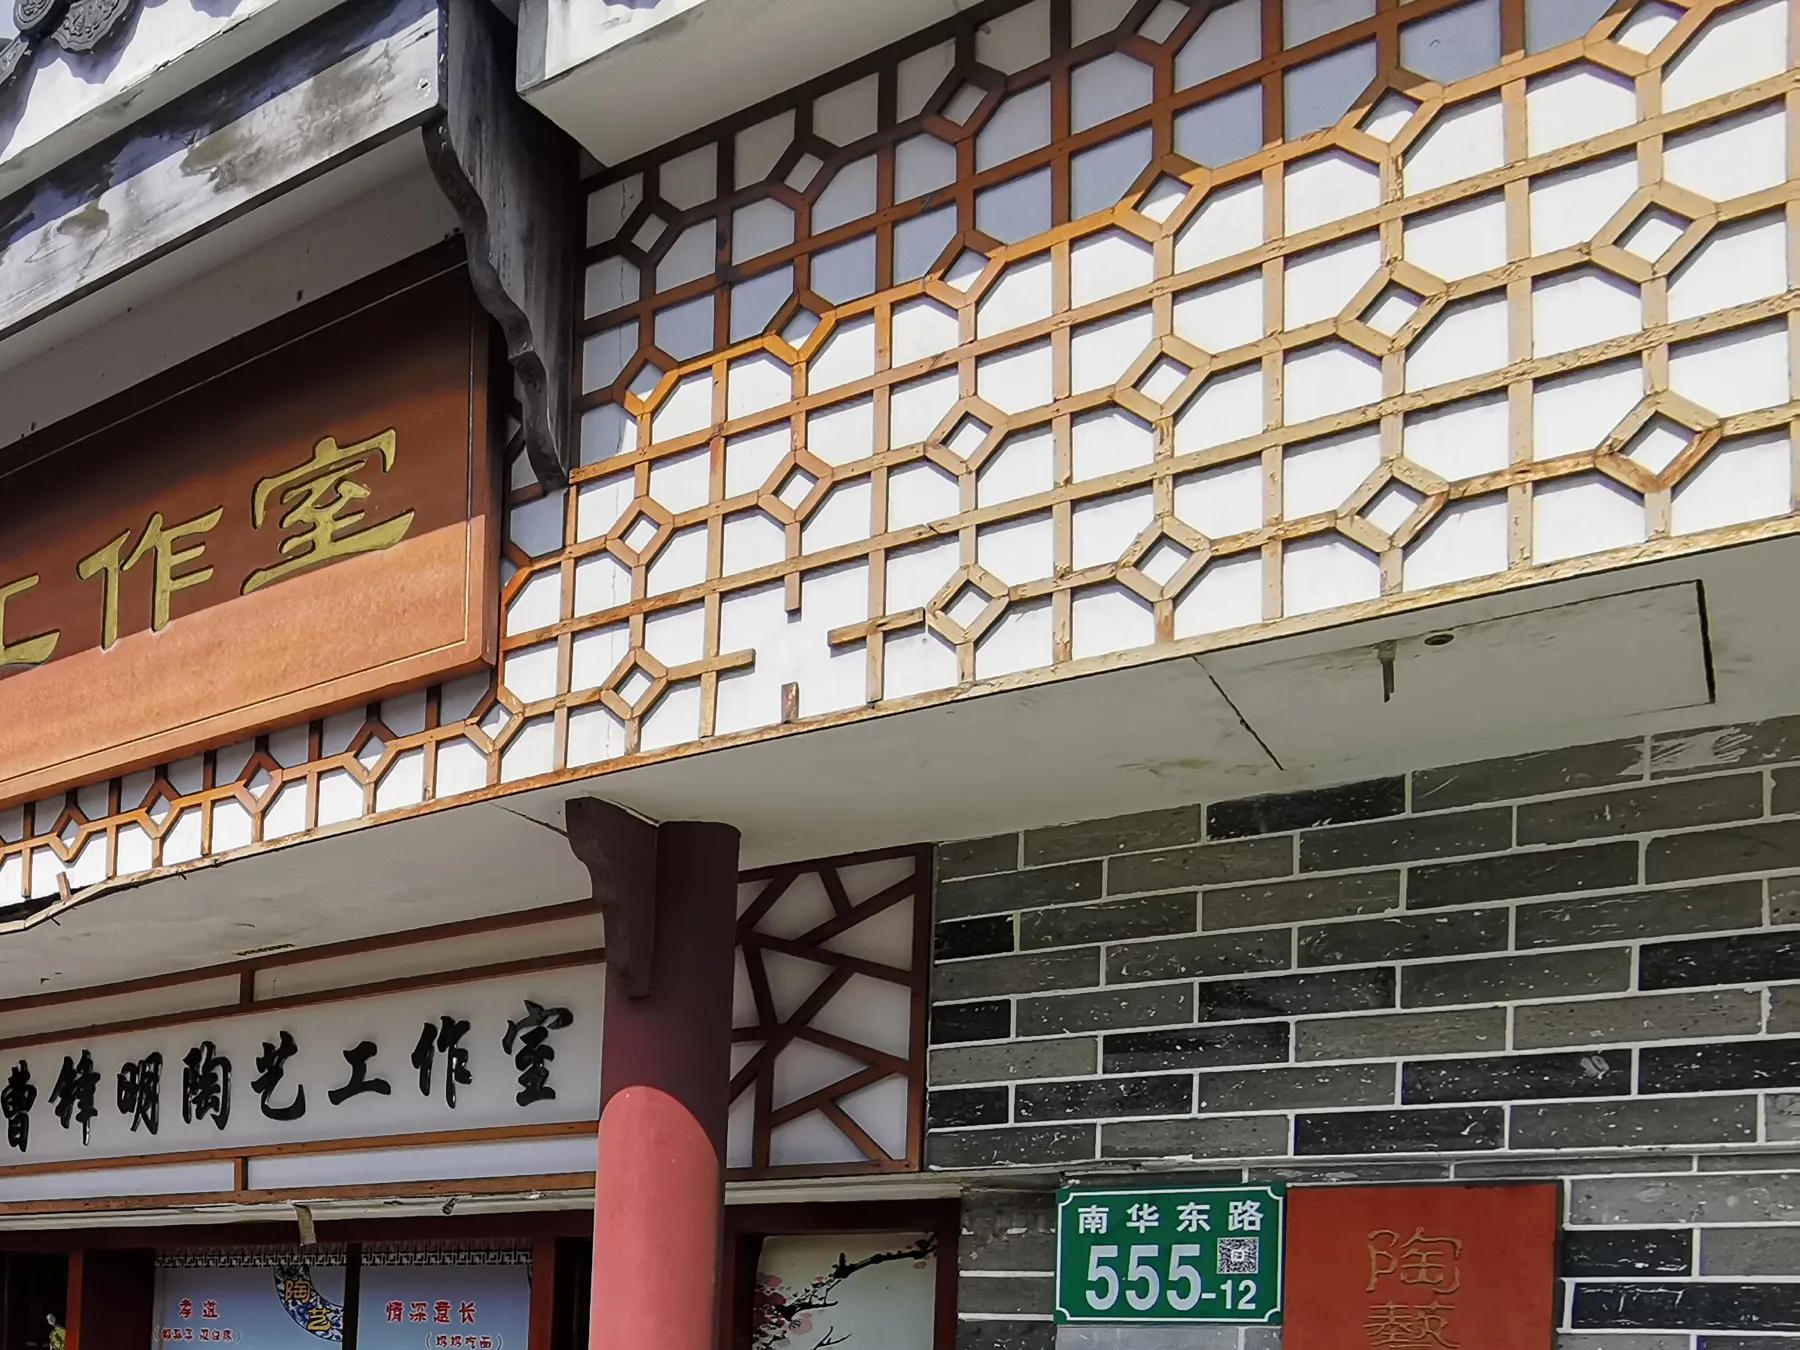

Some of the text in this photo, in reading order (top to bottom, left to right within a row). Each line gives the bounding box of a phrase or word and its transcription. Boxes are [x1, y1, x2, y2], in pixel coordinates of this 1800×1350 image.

[0, 998, 575, 1153] 曹锋明陶艺工作室
[1077, 1199, 1264, 1235] 南华东路
[1085, 1243, 1258, 1311] 555-12
[178, 1298, 219, 1319] 孝道
[284, 1279, 332, 1332] 陶艺
[385, 1300, 477, 1324] 情深意长
